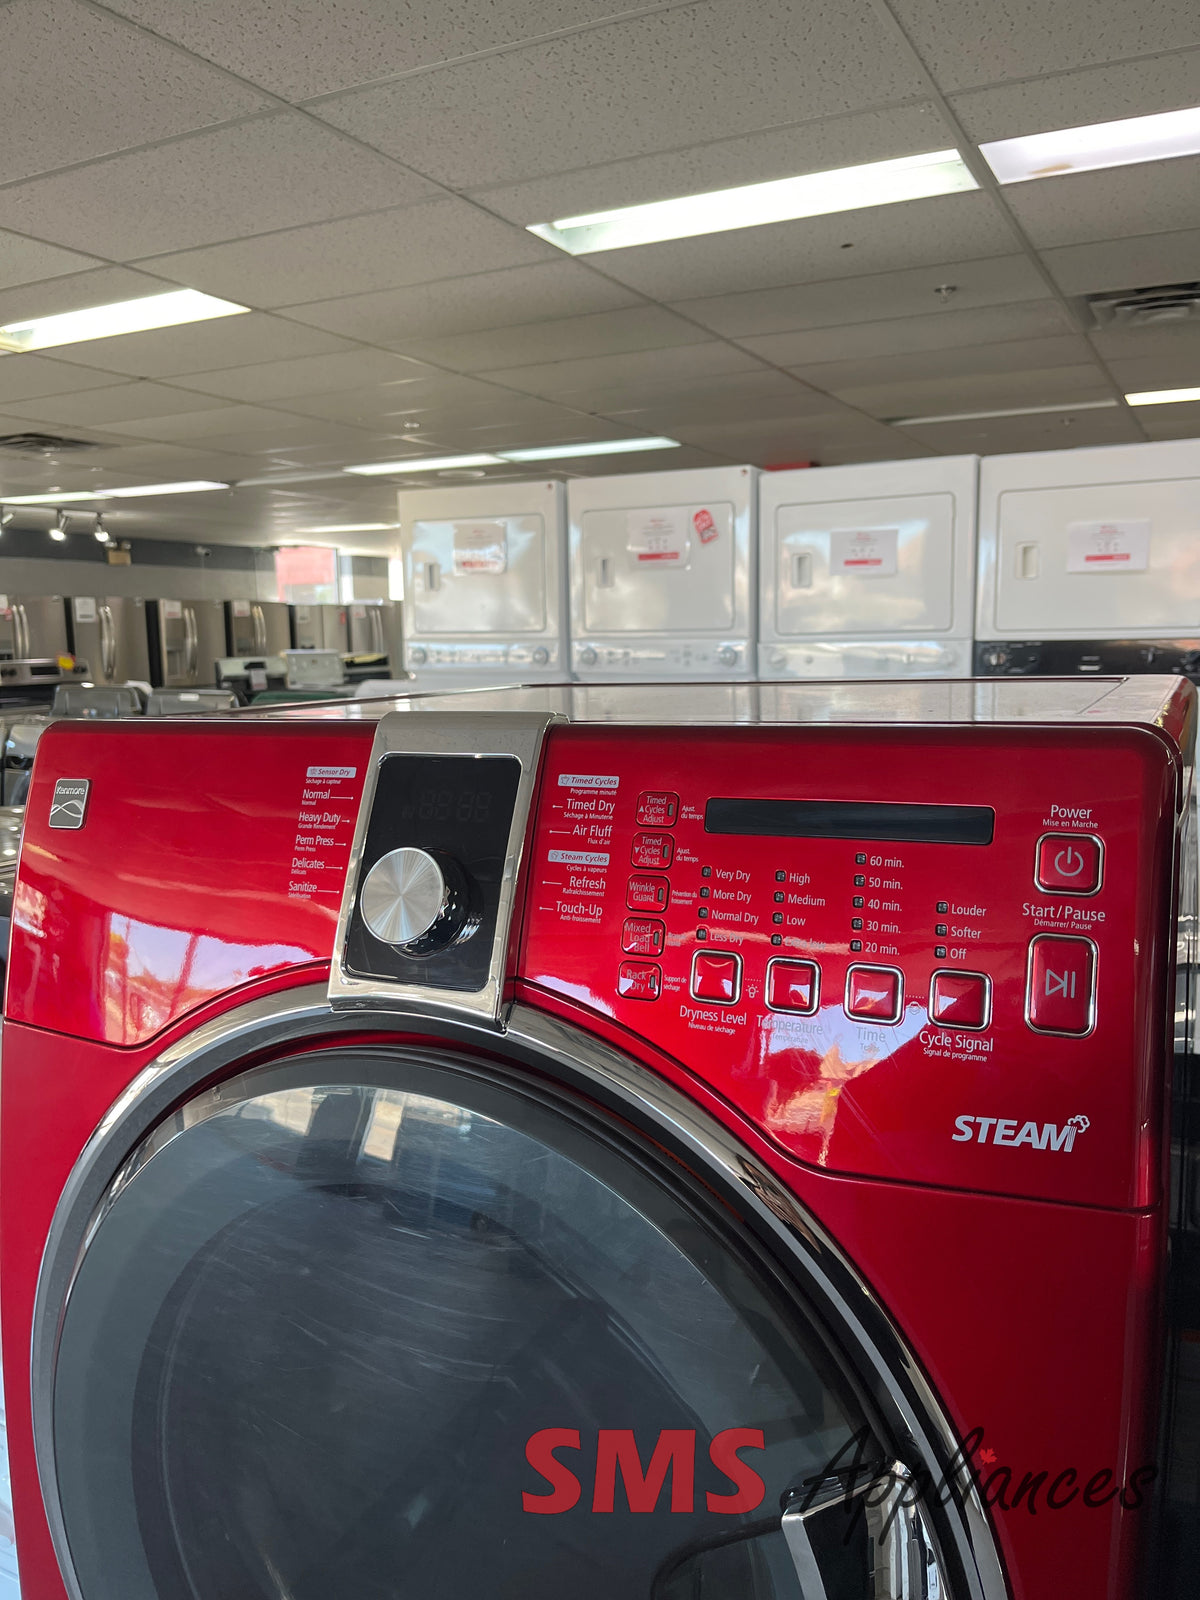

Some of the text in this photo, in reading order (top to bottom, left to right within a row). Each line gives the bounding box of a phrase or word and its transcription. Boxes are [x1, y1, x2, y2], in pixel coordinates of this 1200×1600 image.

[318, 768, 338, 776] Sensor
[571, 776, 617, 786] Timed Cycles
[302, 789, 331, 800] Normal
[570, 788, 598, 796] Programme
[566, 798, 616, 815] Timed Dry
[646, 796, 667, 805] Timed
[644, 806, 666, 816] Cycles
[1050, 804, 1093, 819] Power
[299, 811, 342, 826] Heavy Duty
[642, 814, 664, 824] Adjust
[1042, 818, 1060, 827] Mise
[1071, 821, 1099, 829] Marche
[572, 824, 613, 837] Air Fluff
[295, 834, 335, 846] Perm Press
[641, 836, 662, 846] Timed
[640, 846, 661, 856] Cycles
[291, 857, 325, 869] Delicates
[560, 852, 608, 863] Steam Cycles
[638, 855, 660, 865] Adjust
[870, 856, 905, 868] 60 min.
[566, 864, 582, 872] Cycles
[715, 868, 751, 883] Very Dry
[789, 872, 811, 886] High
[288, 880, 317, 893] Sanitize
[569, 875, 606, 890] Refresh
[629, 881, 656, 893] Wrinkle
[868, 876, 903, 890] 50 min.
[632, 892, 655, 903] Guard
[713, 889, 752, 904] More Dry
[787, 894, 826, 906] Medium
[556, 900, 603, 919] Touch-Up
[867, 899, 903, 912] 40 min.
[951, 903, 987, 917] Louder
[711, 909, 760, 926] Normal Dry
[786, 915, 806, 926] Low
[624, 922, 652, 934] Mixed
[866, 920, 901, 934] 30 min.
[1070, 921, 1092, 930] Pause
[950, 925, 982, 940] Softer
[629, 934, 651, 944] Load
[710, 932, 744, 946] Less Dry
[633, 942, 650, 953] Bell
[865, 942, 900, 956] 20 min.
[950, 948, 967, 960] Off
[626, 968, 646, 980] Rack
[630, 981, 646, 992] Dry
[679, 1005, 747, 1026] Dryness Level
[688, 1021, 736, 1035] Niveau de séchage
[756, 1014, 824, 1035] Temperature
[856, 1026, 887, 1043] Time
[919, 1030, 994, 1053] Cycle Signal
[923, 1048, 988, 1063] Signal de programme
[951, 1114, 1078, 1153] STEAM
